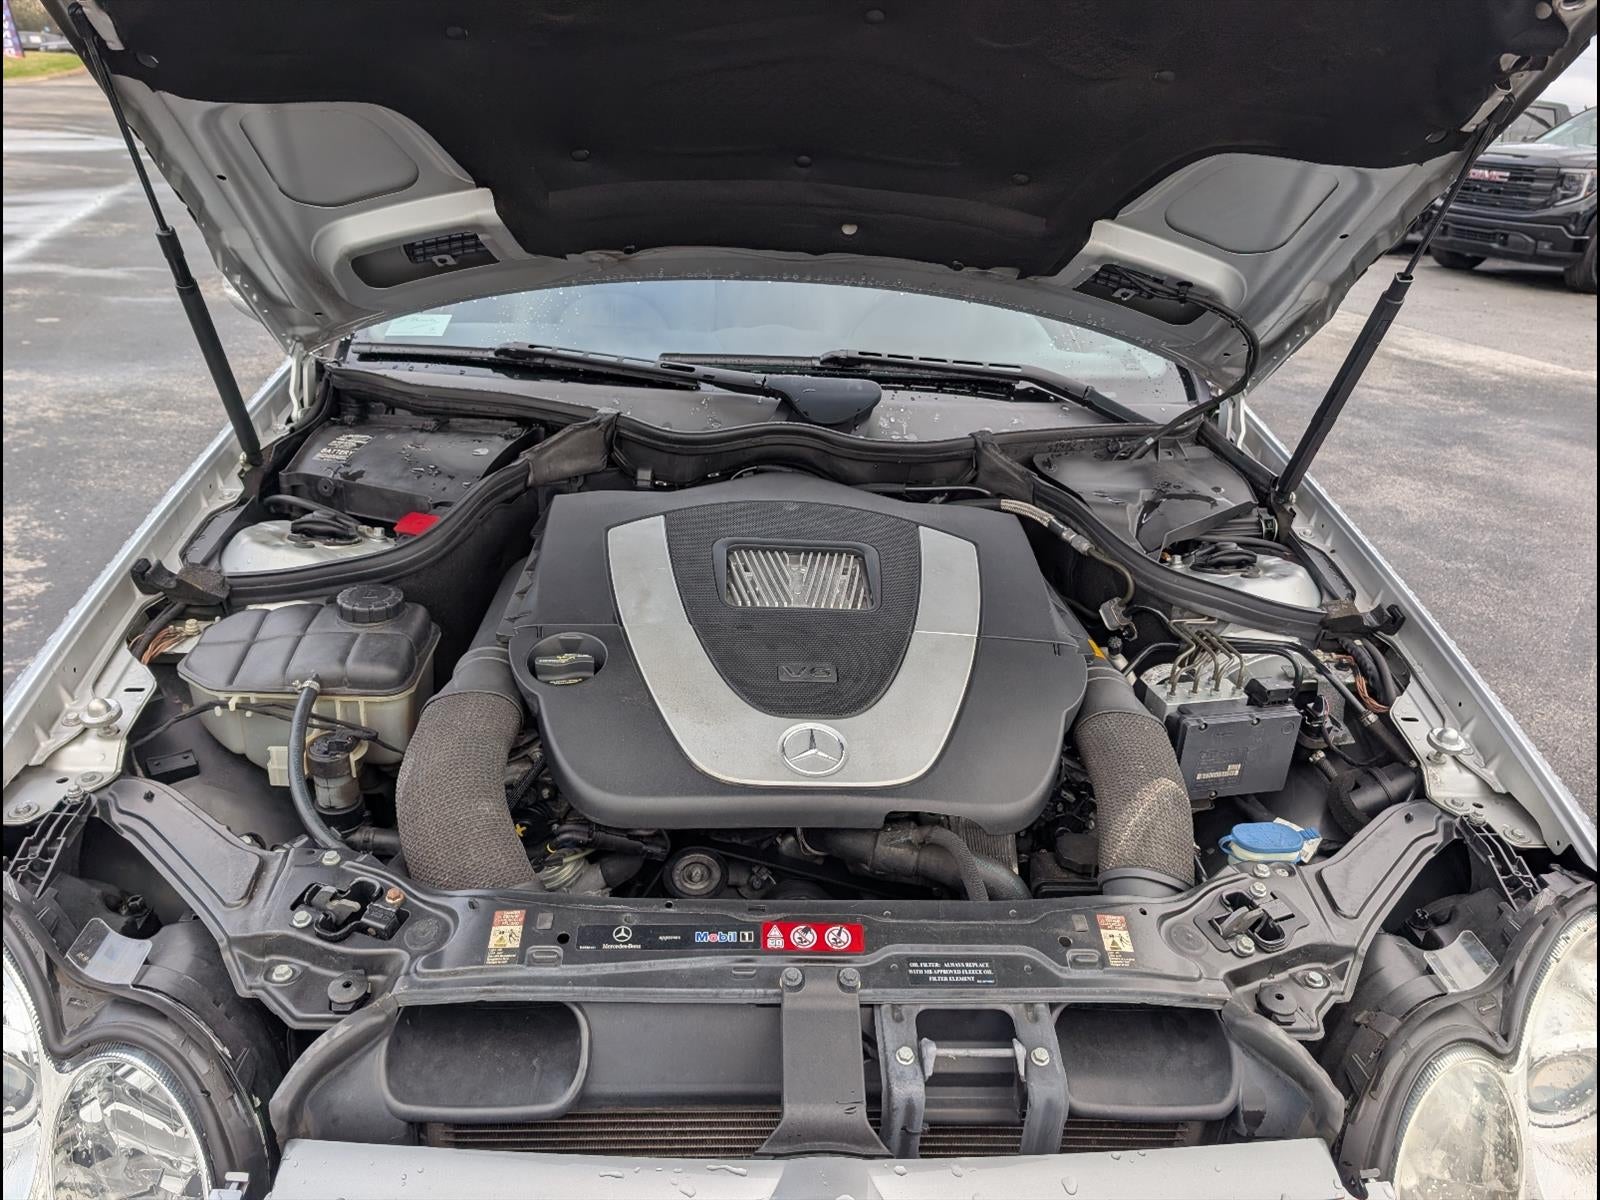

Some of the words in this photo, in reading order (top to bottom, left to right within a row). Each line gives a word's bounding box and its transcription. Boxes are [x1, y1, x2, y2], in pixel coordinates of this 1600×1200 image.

[1469, 169, 1510, 182] GMC
[320, 448, 353, 456] BATTERY
[695, 931, 737, 942] Mobil
[740, 931, 754, 942] 1
